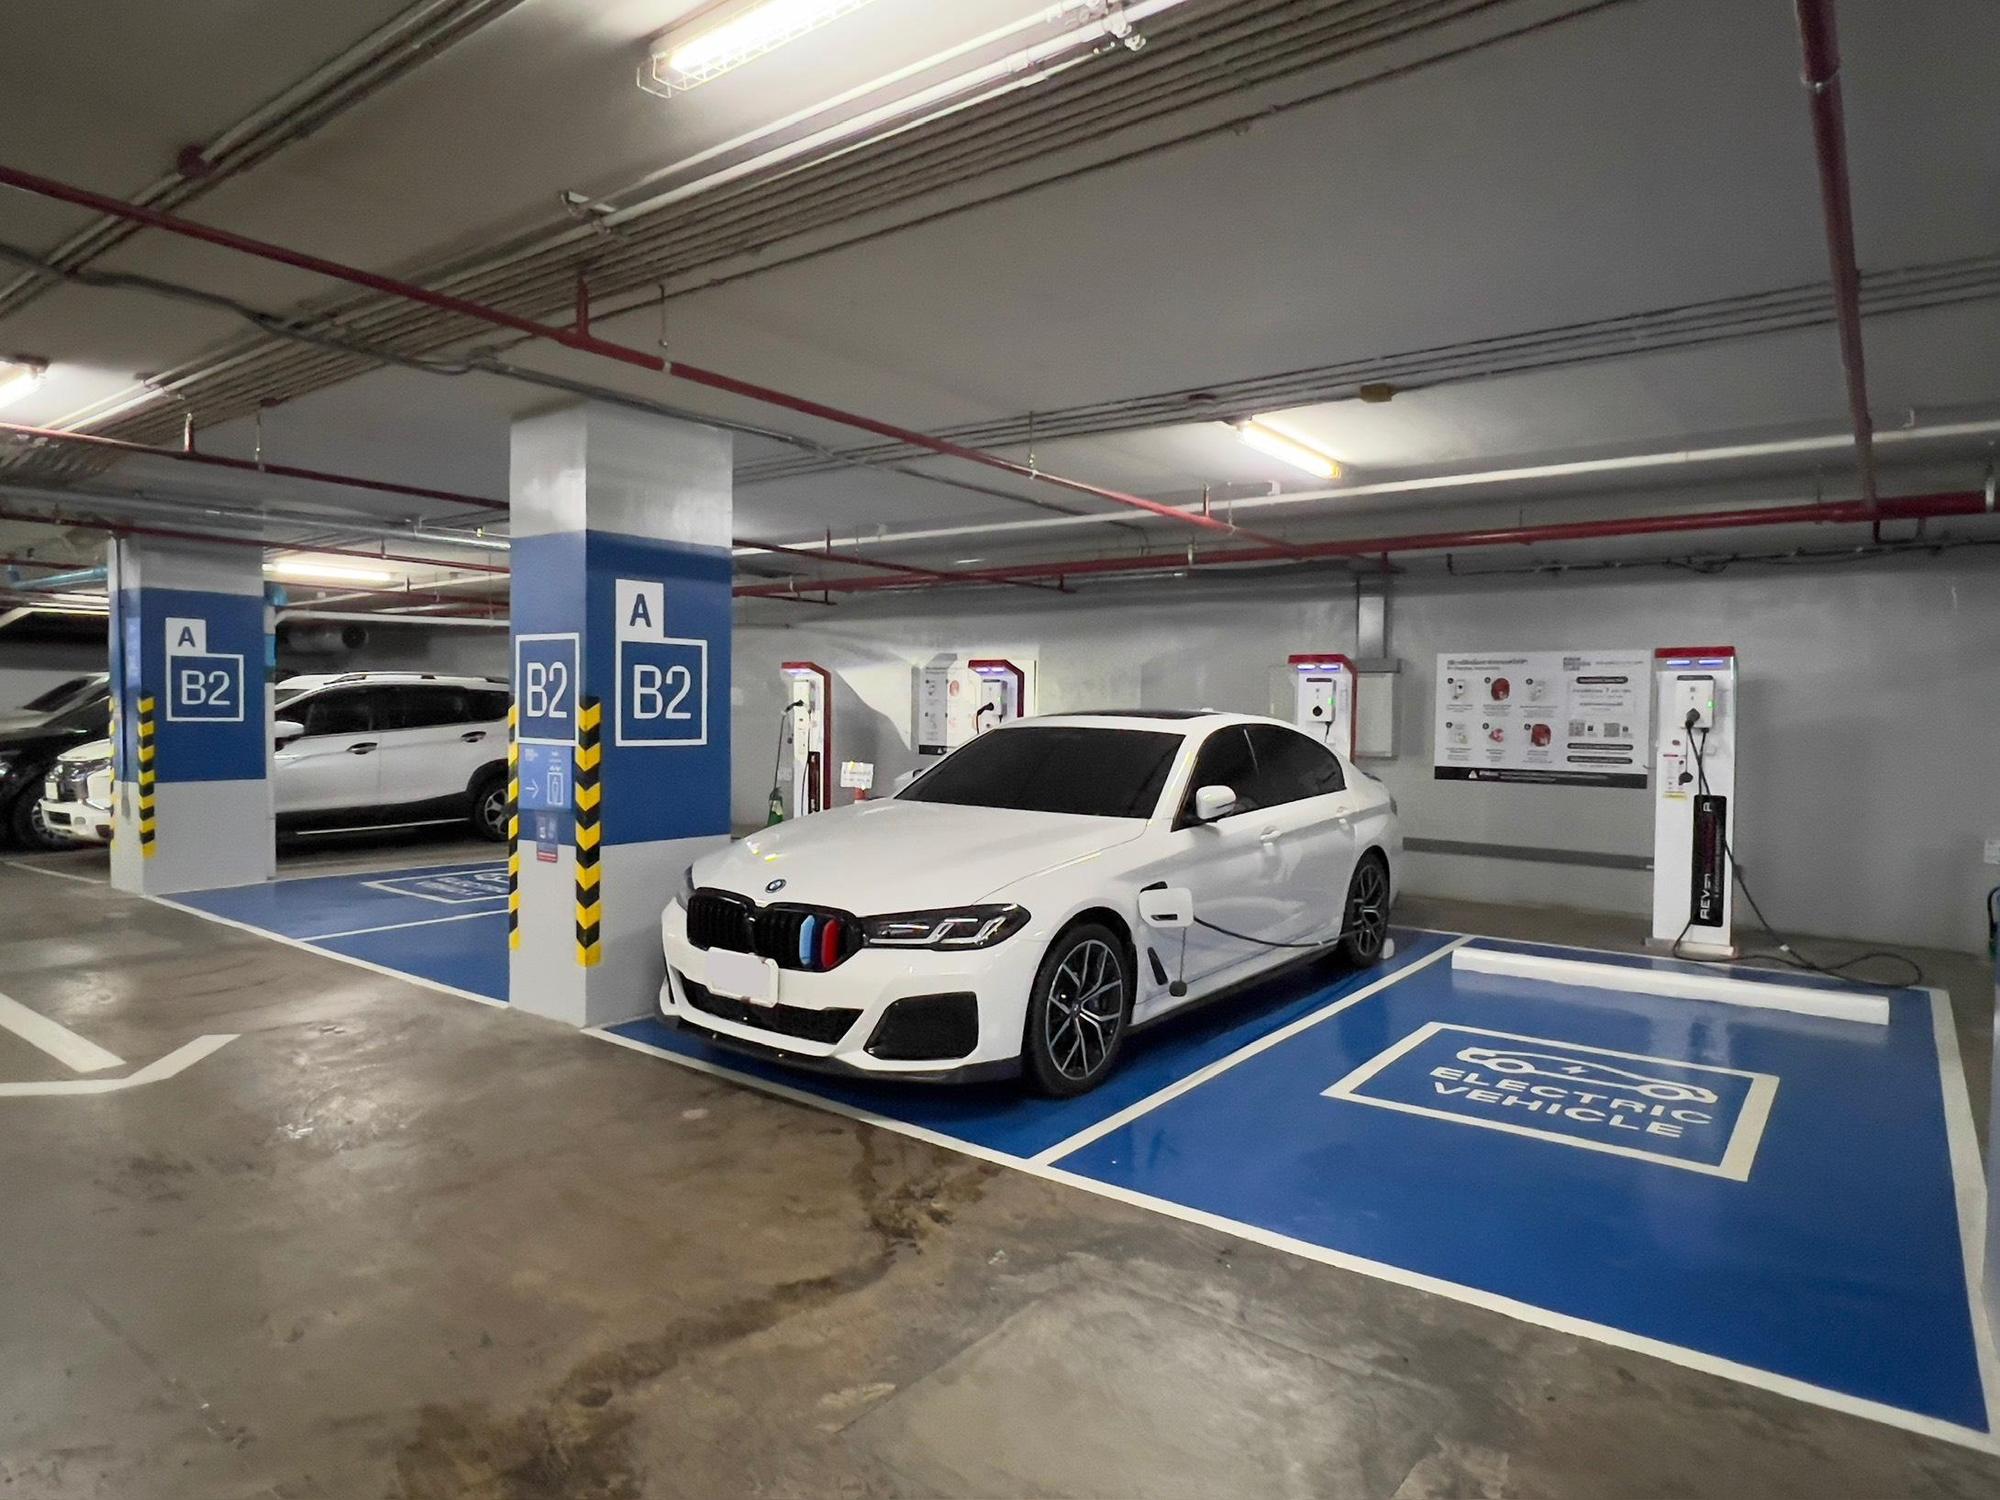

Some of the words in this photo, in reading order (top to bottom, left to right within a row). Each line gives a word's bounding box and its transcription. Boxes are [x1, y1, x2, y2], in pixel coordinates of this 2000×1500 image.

[178, 626, 196, 648] A
[628, 593, 652, 628] A
[181, 669, 231, 706] B2
[526, 661, 568, 719] B2
[633, 664, 692, 720] B2
[1429, 1066, 1713, 1124] ELECTRIC
[1434, 1082, 1684, 1138] VEHICLE
